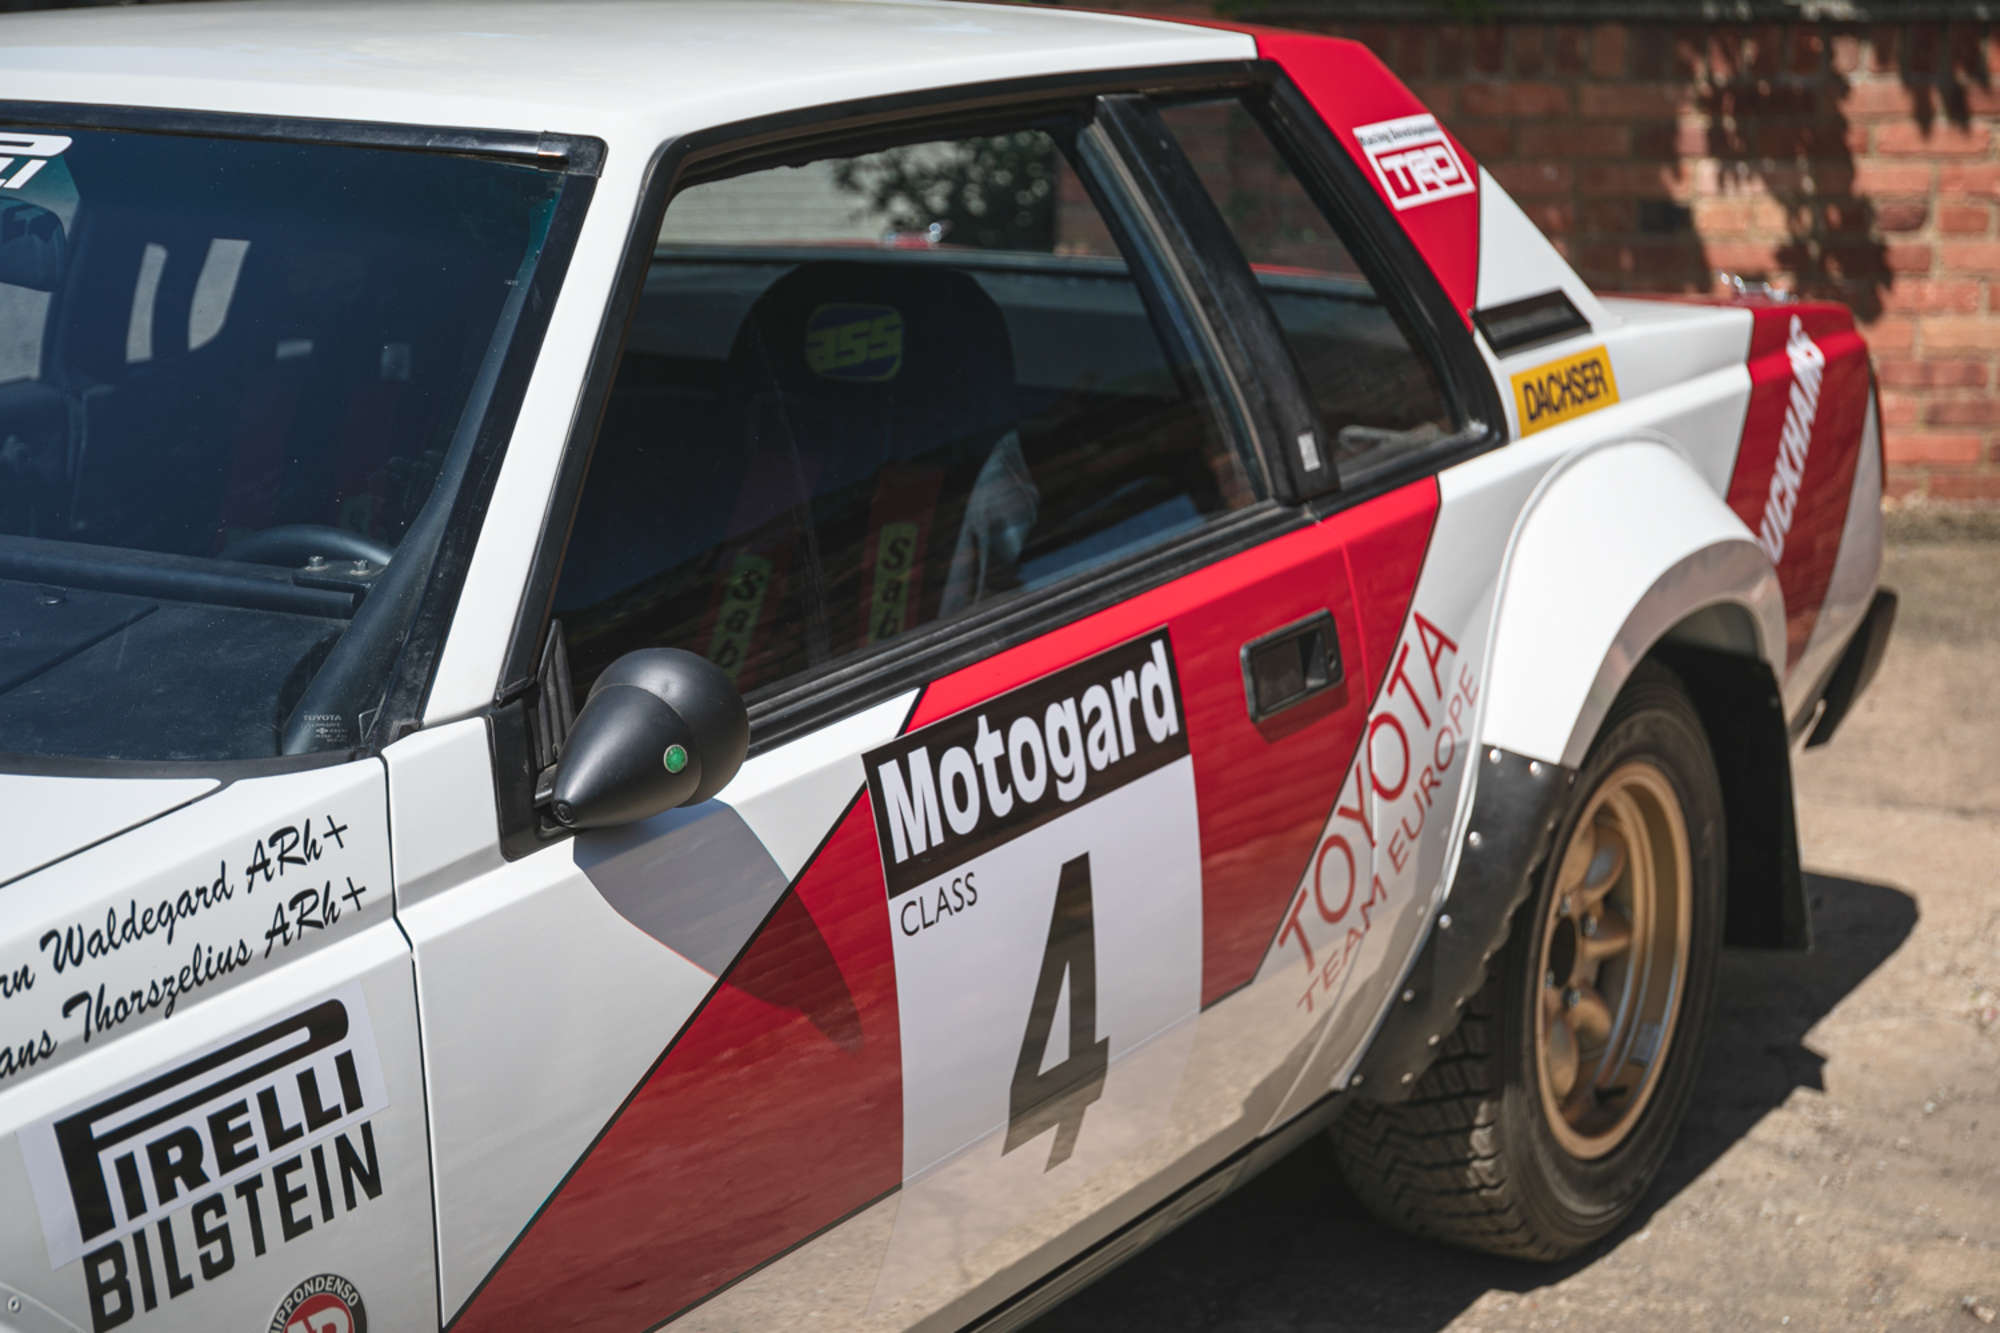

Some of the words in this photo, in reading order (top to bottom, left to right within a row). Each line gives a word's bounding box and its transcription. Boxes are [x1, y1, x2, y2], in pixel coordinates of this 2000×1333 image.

[1523, 357, 1609, 421] DACHSER
[1760, 313, 1826, 565] UCKHAMS
[878, 640, 1179, 864] Motogard
[1279, 610, 1458, 974] TOYOTA
[1297, 873, 1387, 1014] TEAM
[1388, 662, 1480, 874] EUROPE
[0, 1029, 58, 1079] ans
[62, 943, 253, 1043] Thorszelius
[39, 860, 234, 974] Waldegard
[901, 872, 978, 937] CLASS
[1002, 850, 1110, 1174] 4
[53, 999, 364, 1243] PIRELLI
[82, 1120, 383, 1333] BILSTEIN
[271, 1275, 359, 1333] IPPONDENSO
